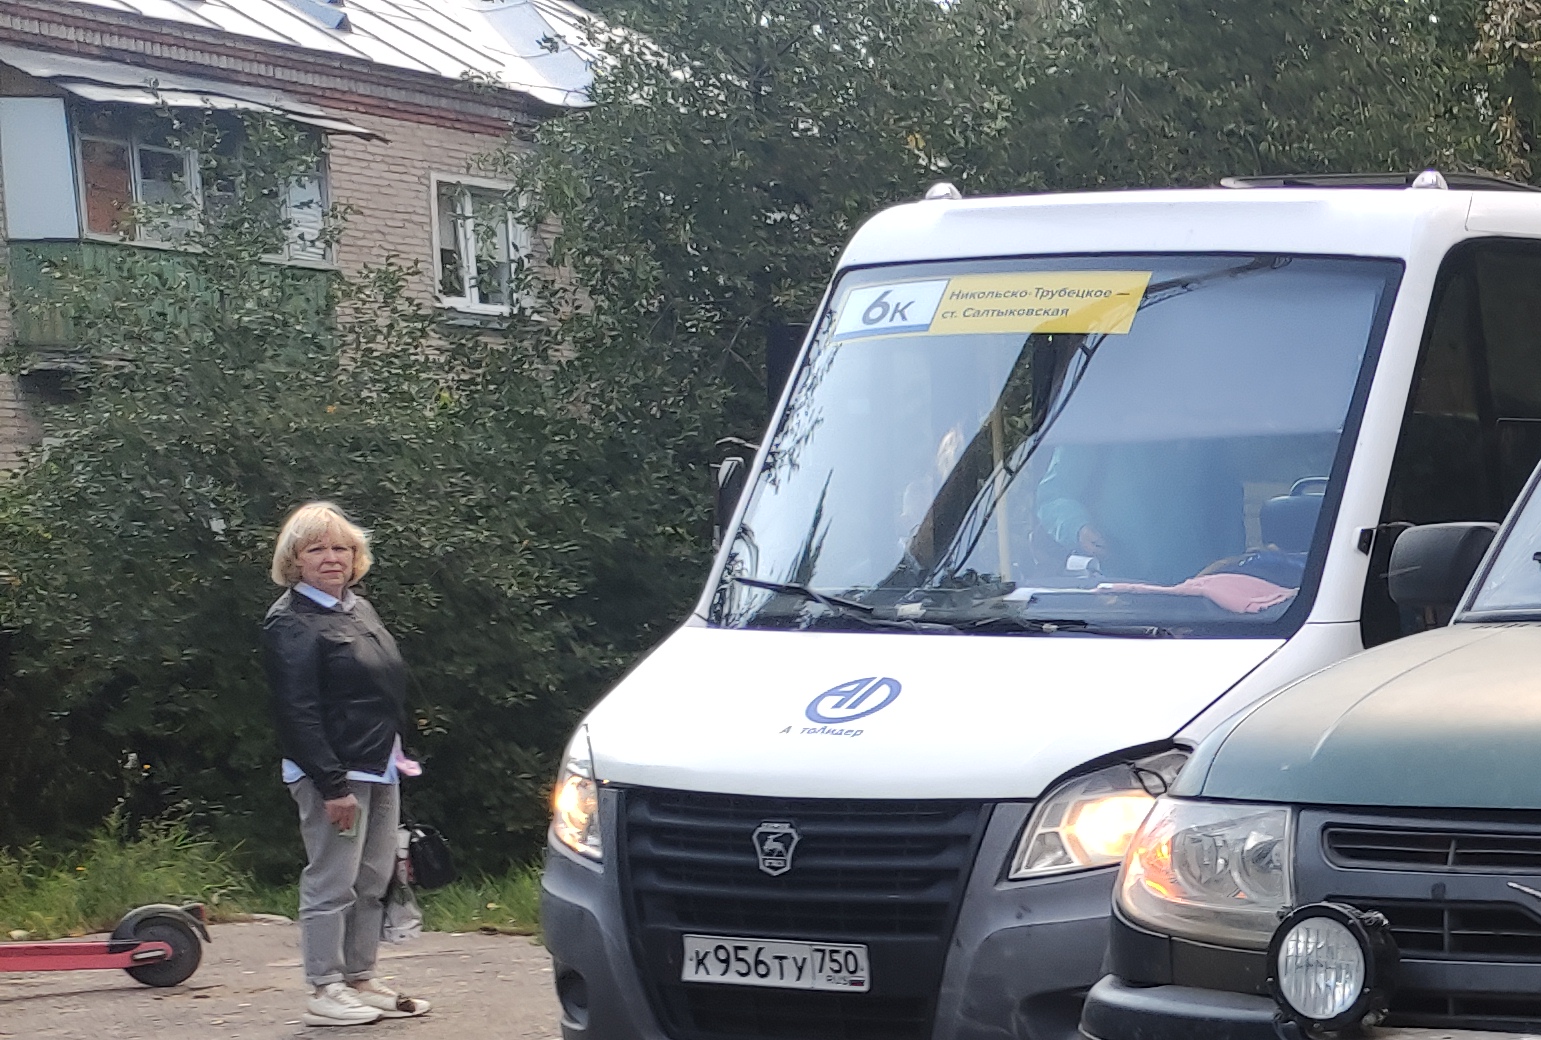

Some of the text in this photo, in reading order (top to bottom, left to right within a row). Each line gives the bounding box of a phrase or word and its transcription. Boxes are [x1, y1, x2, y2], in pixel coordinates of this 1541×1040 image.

[949, 287, 1113, 300] Никольско-Трубецкое
[941, 307, 1070, 319] ст. Салтыковская
[694, 944, 858, 982] К956ТУ 750
